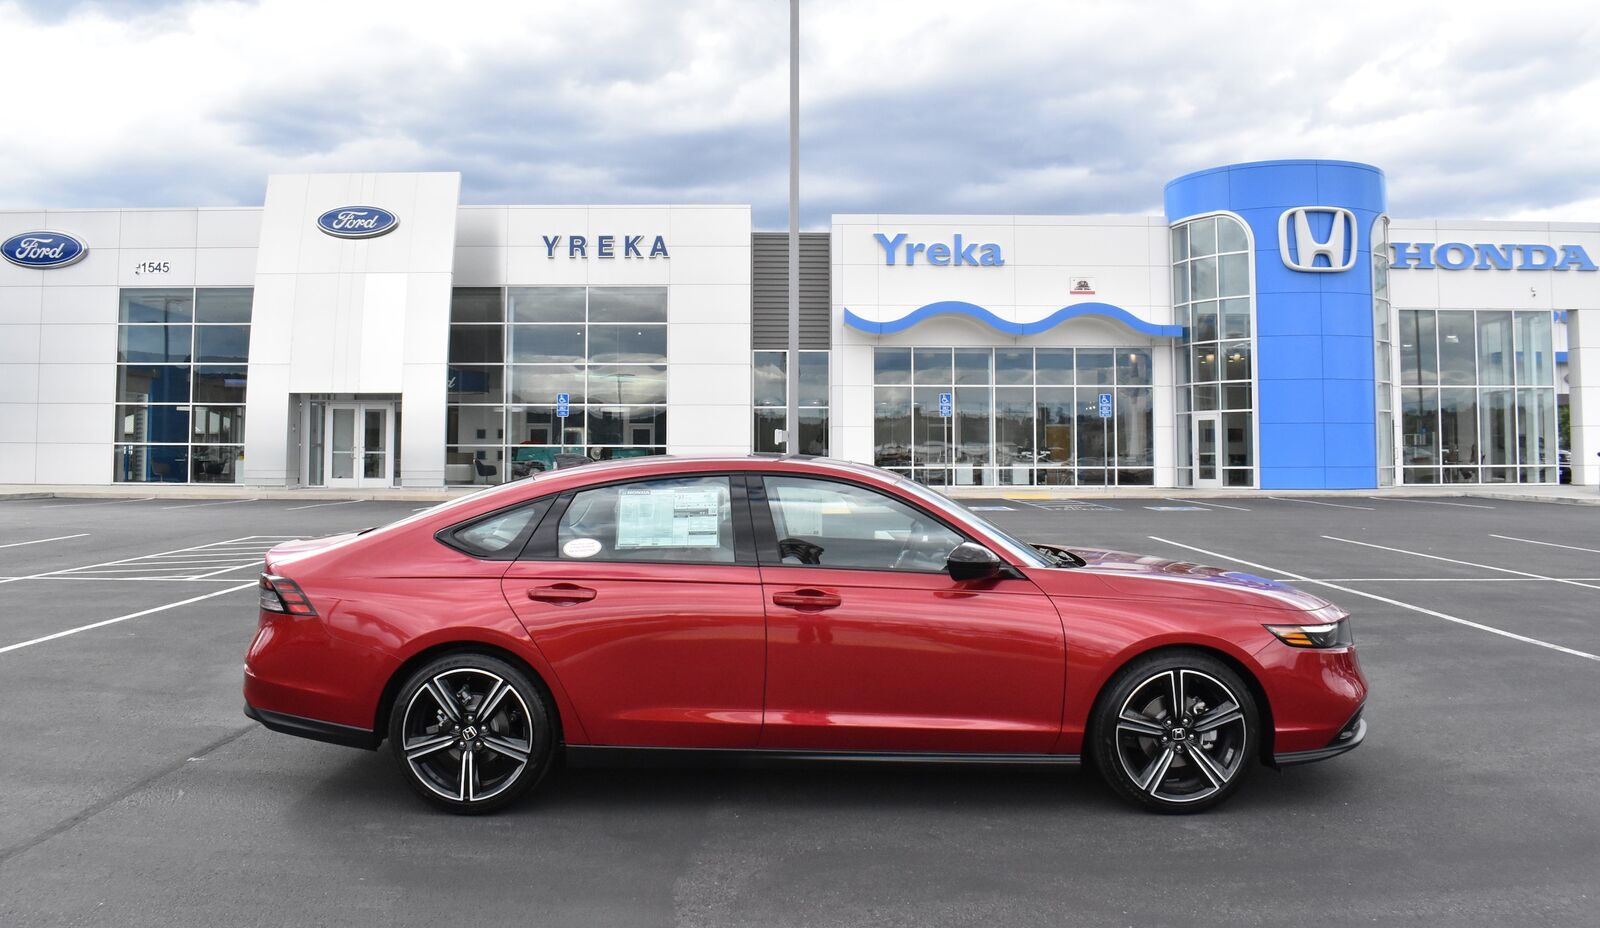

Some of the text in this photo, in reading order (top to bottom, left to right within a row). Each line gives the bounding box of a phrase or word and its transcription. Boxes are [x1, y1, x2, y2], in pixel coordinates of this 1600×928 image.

[332, 211, 379, 229] Ford
[15, 237, 65, 259] Ford
[542, 235, 670, 259] YREKA
[873, 233, 1005, 267] Yreka
[1390, 242, 1599, 271] HONDA
[141, 262, 170, 273] 1545
